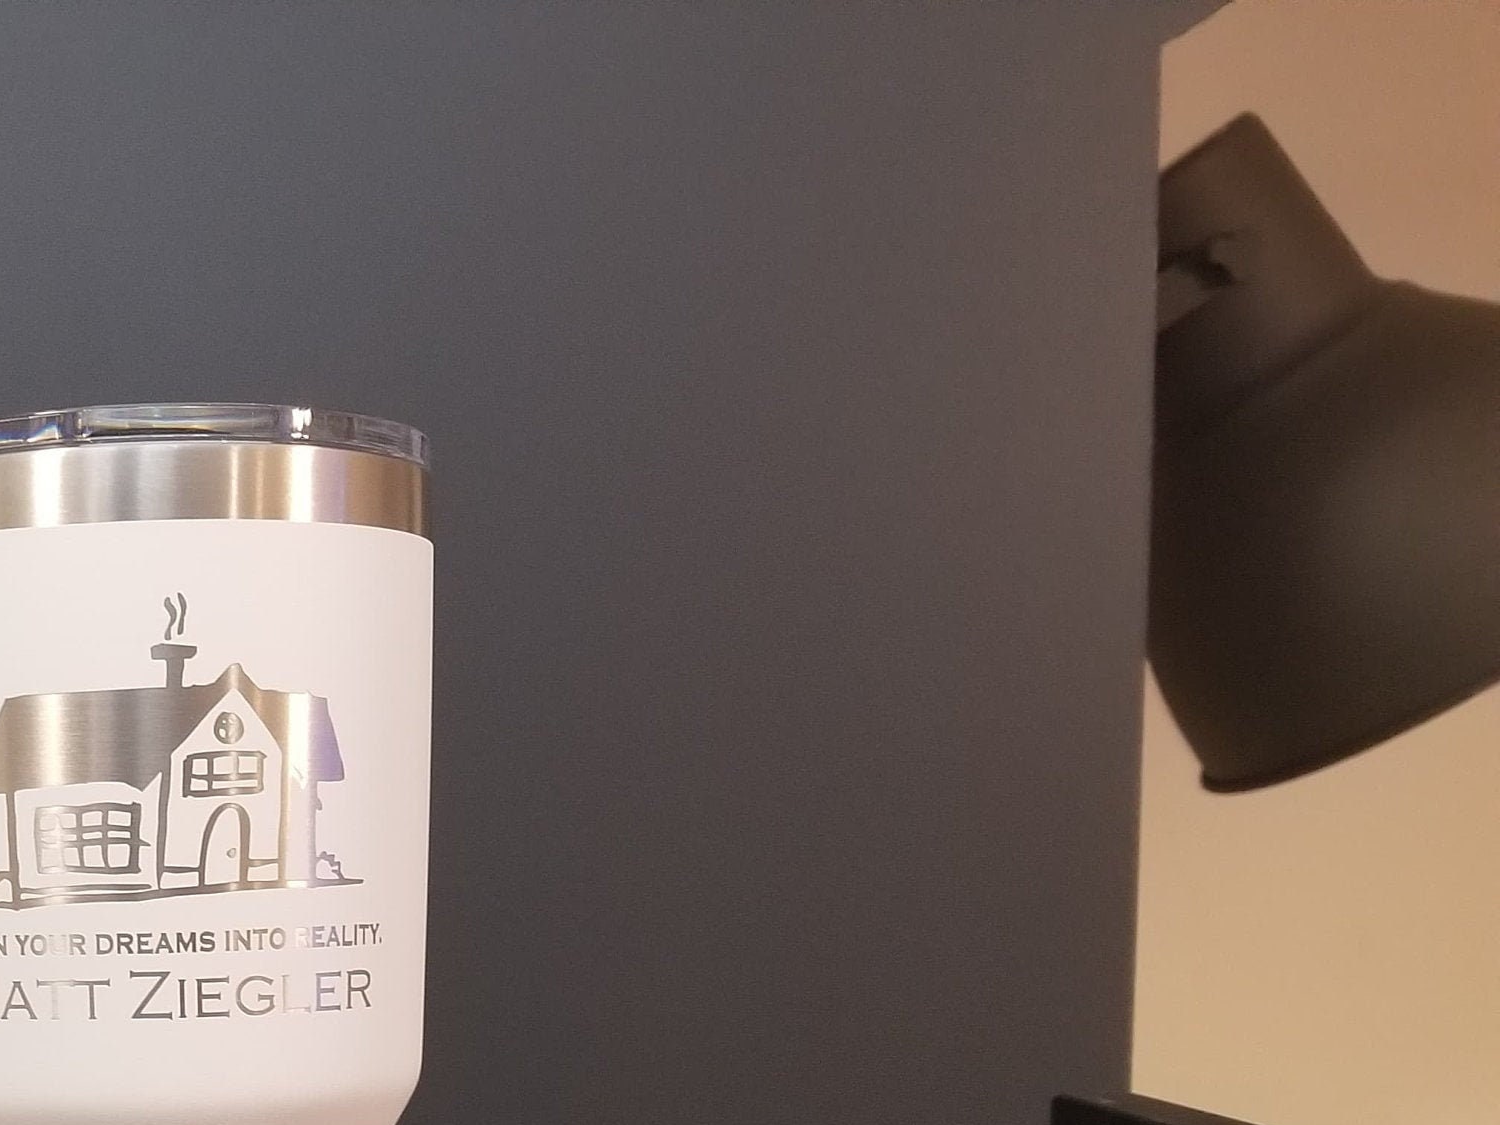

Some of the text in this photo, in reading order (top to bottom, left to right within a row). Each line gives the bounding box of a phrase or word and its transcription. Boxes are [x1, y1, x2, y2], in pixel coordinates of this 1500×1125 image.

[95, 931, 216, 955] DREAMS
[225, 927, 286, 951] INTO
[130, 969, 372, 1020] ZIEGLER
